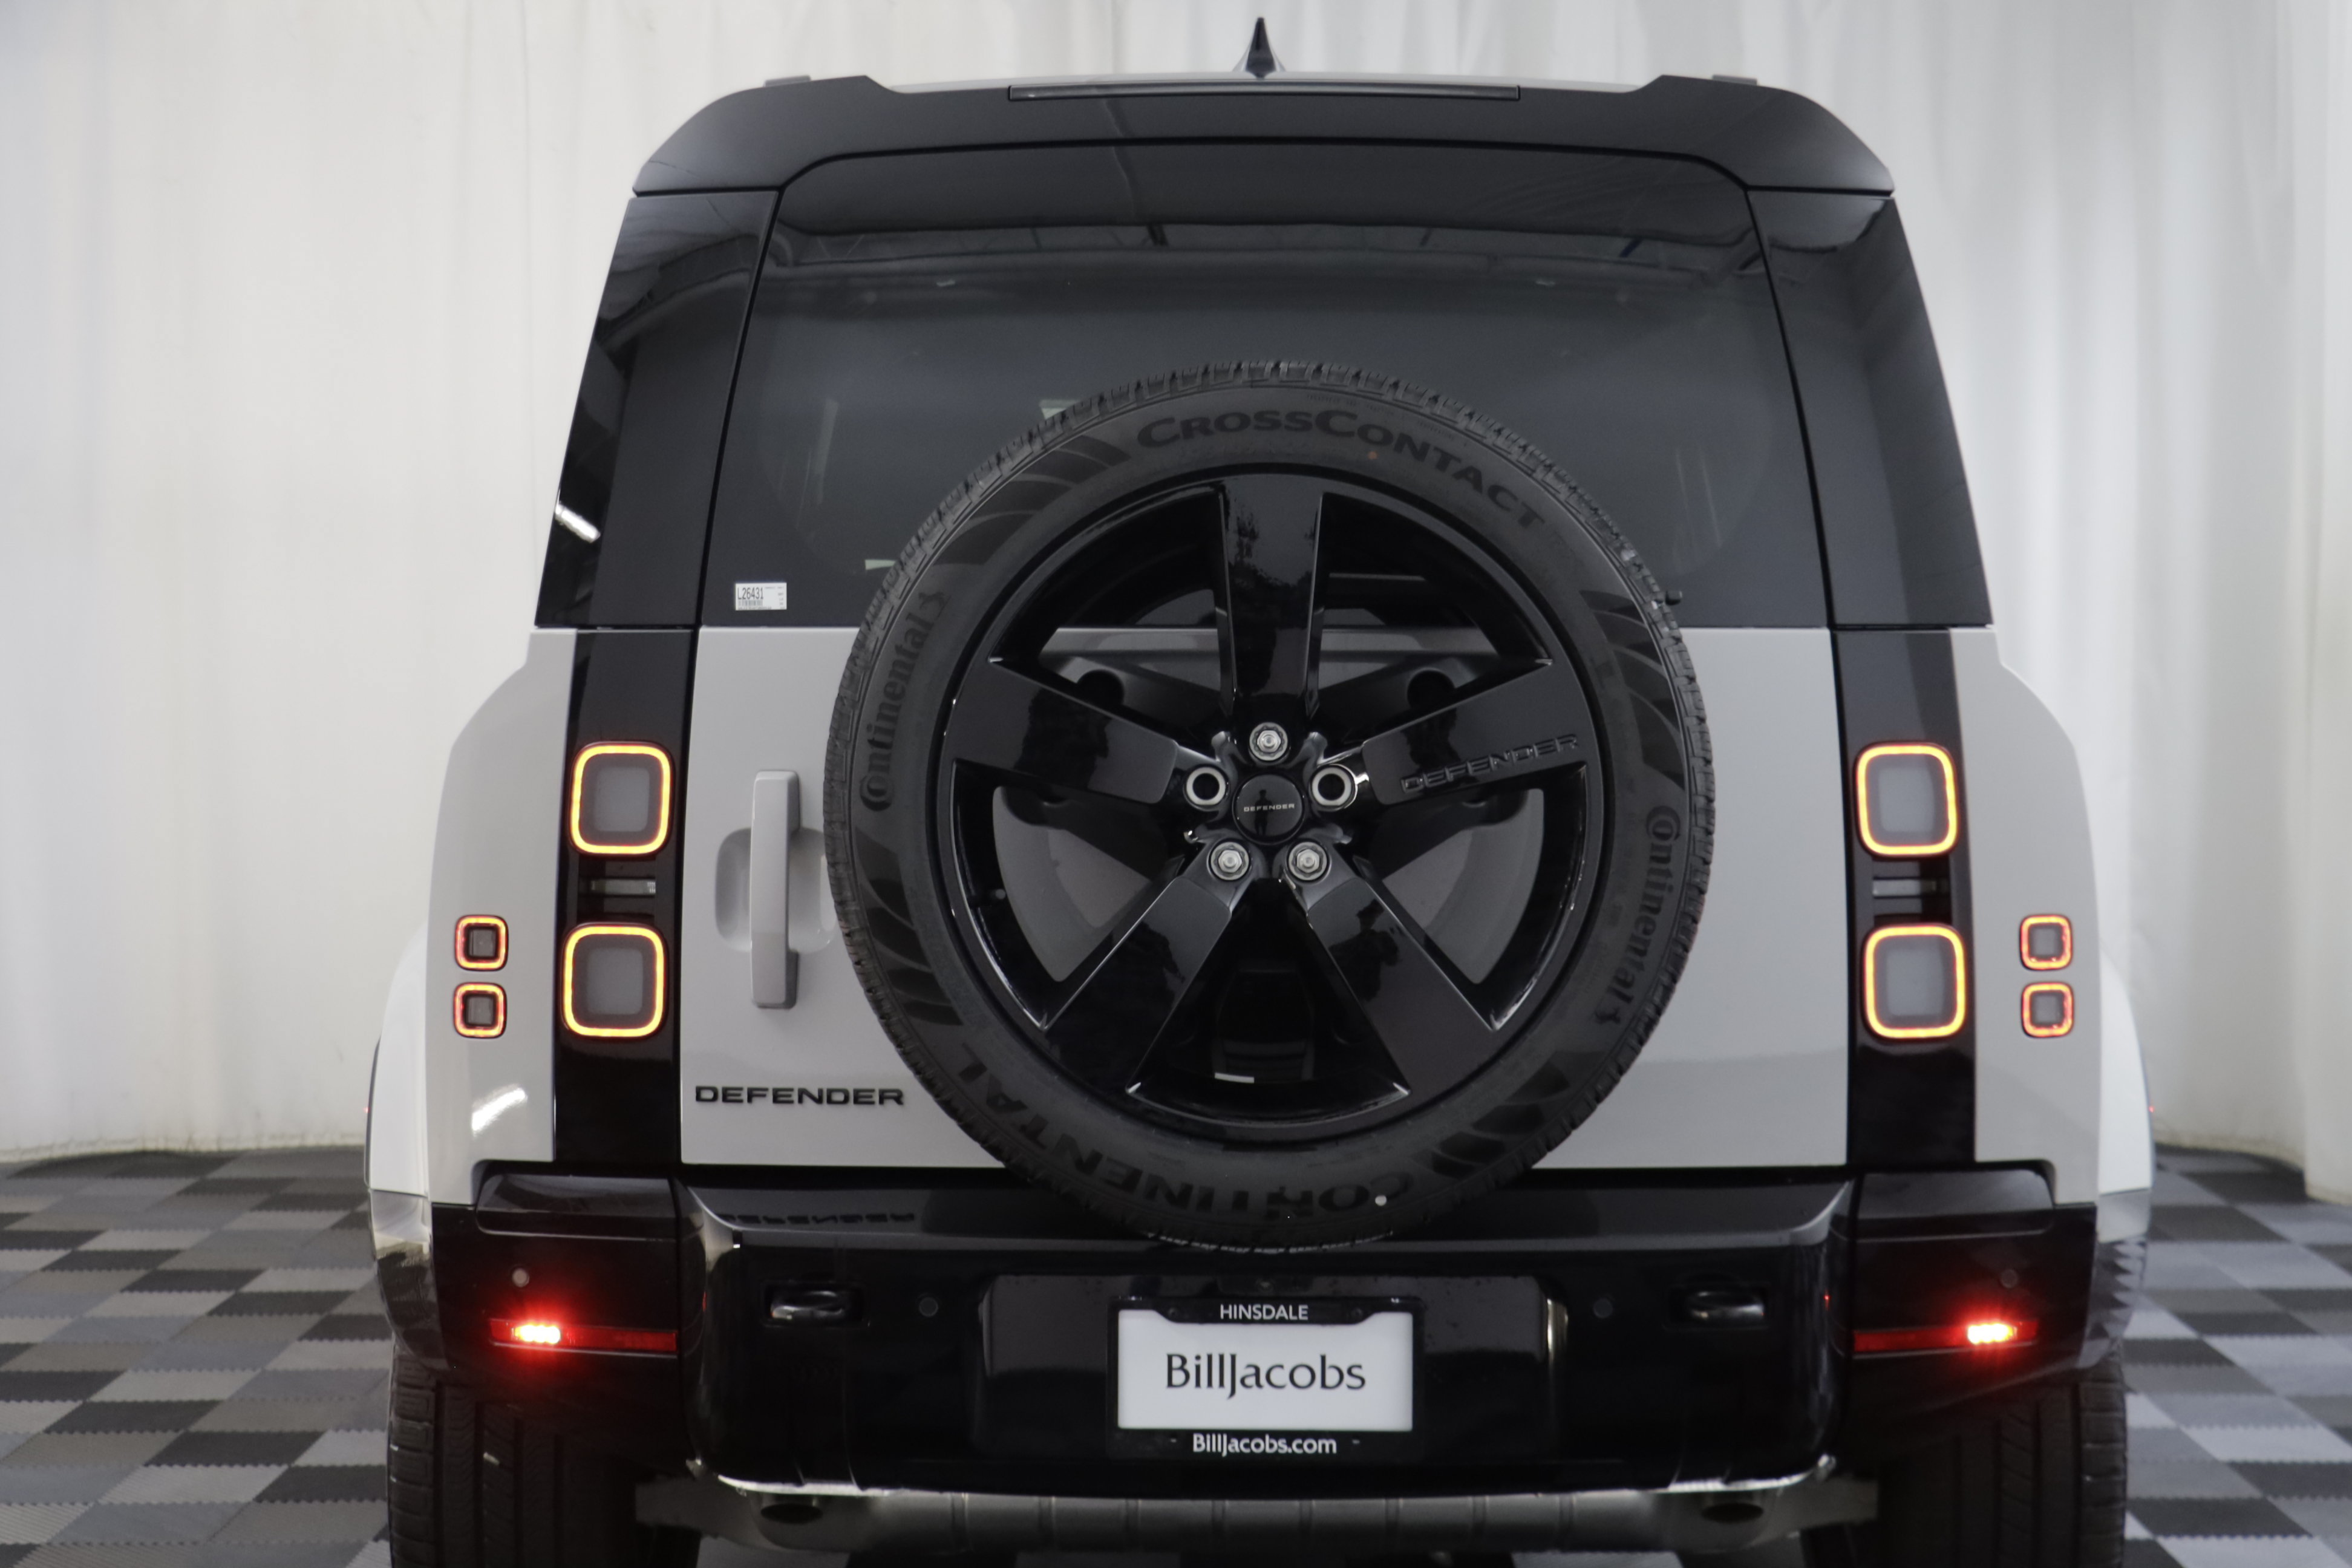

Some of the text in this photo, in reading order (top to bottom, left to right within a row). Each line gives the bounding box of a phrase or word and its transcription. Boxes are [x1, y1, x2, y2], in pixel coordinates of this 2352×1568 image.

[737, 587, 764, 600] L26431
[860, 612, 935, 811] Continental
[1400, 734, 1578, 793] DEFENDER
[1244, 803, 1295, 812] DEFENDER
[1607, 805, 1681, 1004] Continental
[695, 1086, 904, 1105] DEFENDER
[962, 1042, 1414, 1220] CONTINENTAL
[1220, 1304, 1309, 1321] HINSDALE
[1166, 1353, 1366, 1400] BillJacobs
[1192, 1433, 1338, 1457] BillJacobs.com
